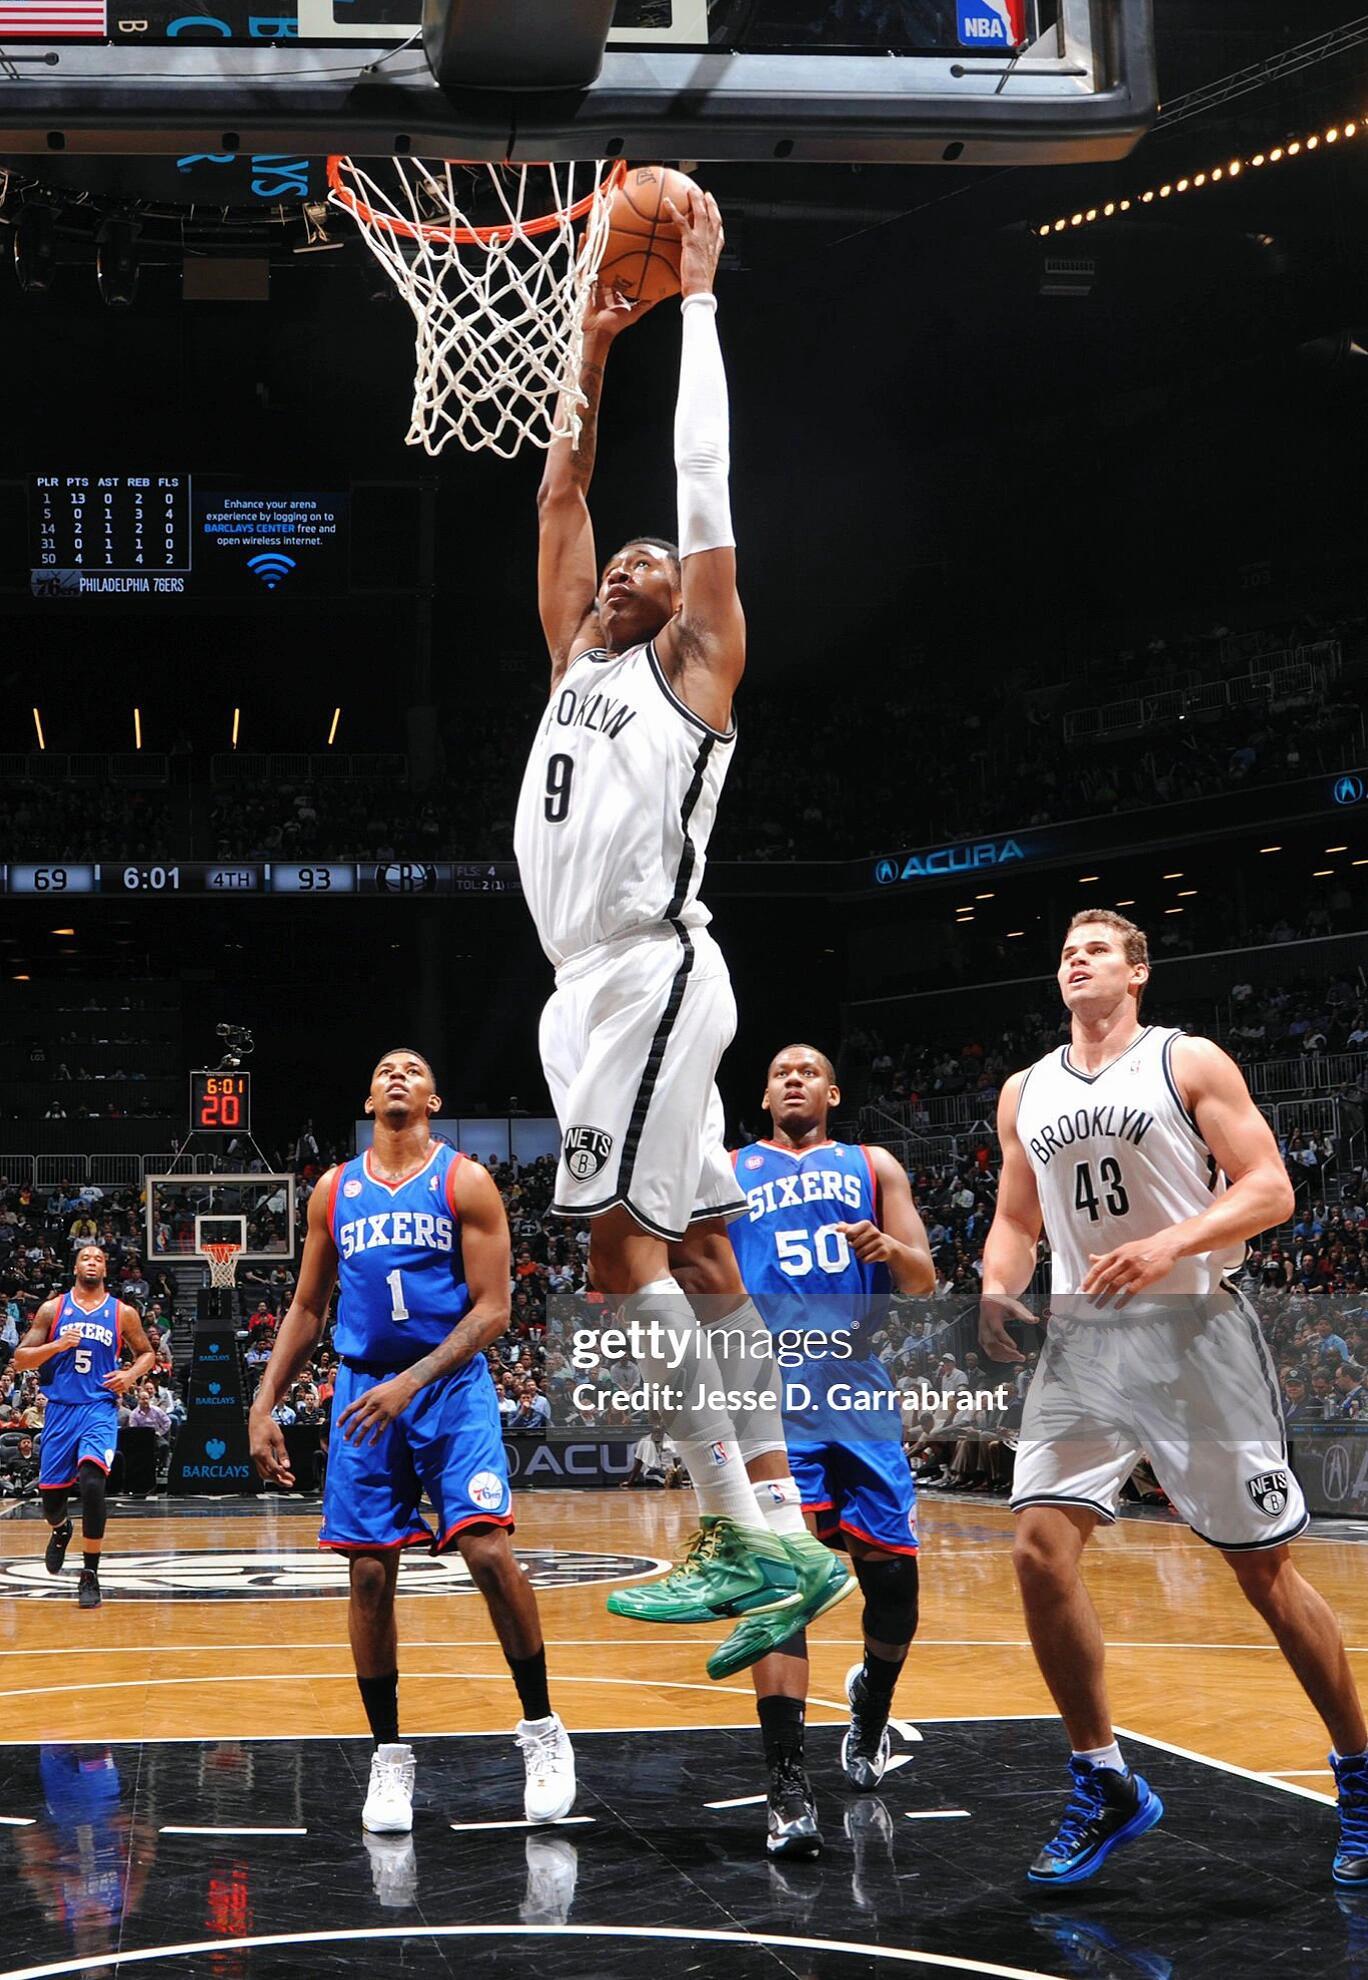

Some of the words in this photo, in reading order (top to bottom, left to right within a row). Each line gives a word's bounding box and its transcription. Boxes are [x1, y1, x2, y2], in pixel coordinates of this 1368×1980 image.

[964, 18, 1003, 37] NBA
[37, 477, 59, 487] PLR
[66, 477, 89, 487] PTS
[98, 477, 119, 487] AST
[127, 477, 150, 487] REB
[158, 477, 179, 487] FLS
[44, 493, 51, 504] 1
[70, 493, 86, 504] 13
[104, 493, 112, 504] 0
[135, 493, 143, 504] 2
[165, 493, 173, 504] 0
[224, 499, 264, 509] Enhance
[266, 501, 287, 511] your
[290, 501, 316, 509] arena
[44, 508, 51, 519] 5
[74, 508, 82, 519] 0
[105, 508, 112, 519] 1
[135, 508, 143, 519] 3
[165, 508, 173, 519] 4
[206, 512, 259, 522] experience
[259, 512, 271, 522] by
[273, 512, 308, 522] logging
[310, 513, 321, 521] on
[324, 513, 334, 521] to
[40, 523, 55, 534] 14
[74, 523, 82, 534] 2
[105, 523, 112, 534] 1
[135, 523, 143, 534] 2
[165, 523, 173, 534] 0
[204, 523, 254, 533] BARCLAYS
[256, 523, 295, 533] CENTER
[297, 523, 316, 533] free
[319, 523, 336, 533] and
[41, 538, 56, 549] 31
[74, 538, 83, 549] 0
[105, 538, 113, 549] 1
[135, 538, 143, 549] 1
[165, 538, 173, 549] 0
[217, 537, 240, 546] open
[242, 536, 281, 545] wireless
[283, 536, 322, 545] internet.
[41, 553, 56, 564] 50
[74, 553, 83, 564] 4
[105, 553, 113, 564] 1
[135, 553, 143, 564] 4
[165, 553, 173, 564] 2
[80, 577, 150, 592] PHILADELPHIA
[153, 577, 184, 592] 76ERS
[544, 753, 574, 823] 9
[901, 839, 1024, 880] ACURA
[34, 868, 67, 890] 69
[123, 866, 179, 889] 6:01
[213, 872, 250, 887] 4TH
[298, 868, 330, 890] 93
[487, 866, 496, 876] 4
[207, 1078, 243, 1094] 6:01
[202, 1095, 239, 1125] 20
[565, 1128, 611, 1157] NETS
[1030, 1106, 1154, 1165] BROOKLYN
[746, 1171, 861, 1223] SIXERS
[1075, 1157, 1130, 1222] 43
[340, 1212, 453, 1260] SIXERS
[774, 1223, 850, 1277] 50
[386, 1269, 410, 1321] 1
[74, 1349, 92, 1374] 5
[196, 1397, 236, 1405] BARCLAYS
[182, 1465, 249, 1478] BARCLAYS
[1250, 1472, 1287, 1497] NETS
